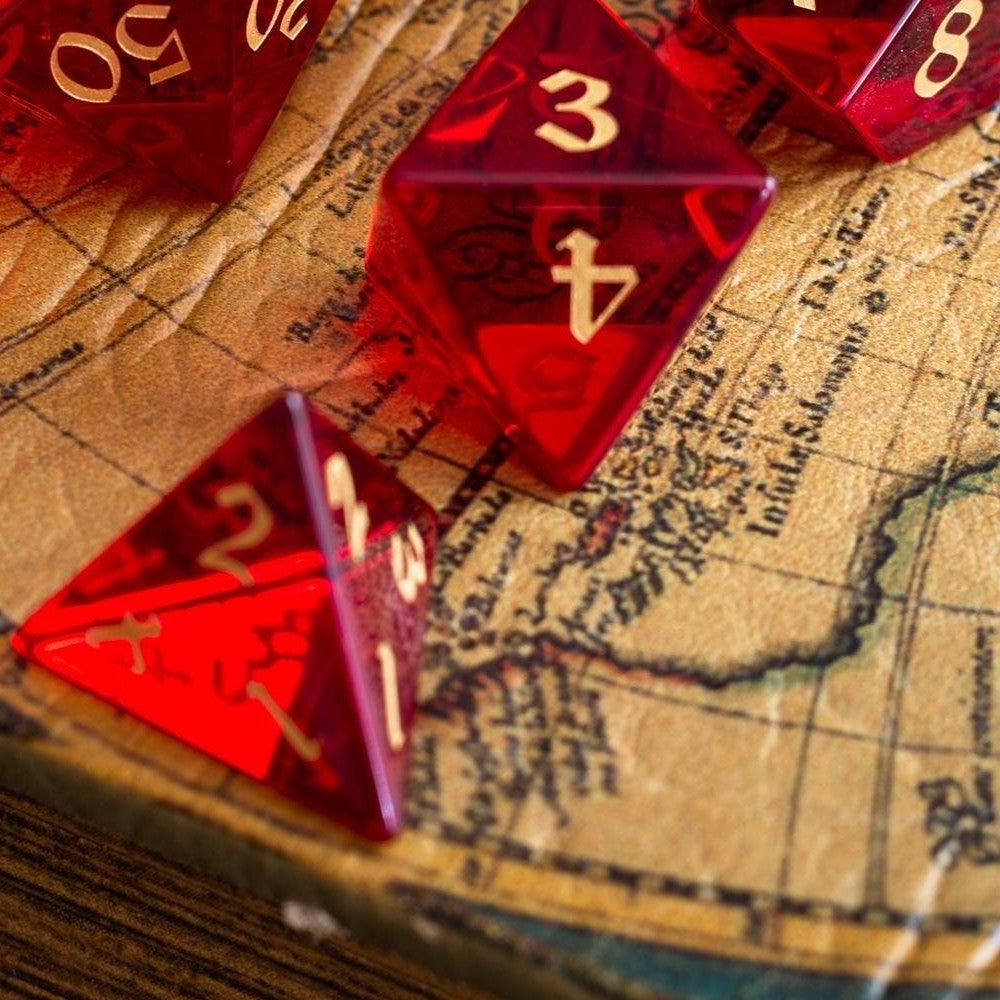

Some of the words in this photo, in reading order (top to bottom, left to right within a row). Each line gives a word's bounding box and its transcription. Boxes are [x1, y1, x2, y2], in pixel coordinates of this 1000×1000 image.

[50, 4, 191, 103] 50
[534, 69, 620, 154] 3
[551, 228, 640, 345] 4
[197, 483, 274, 587] 2
